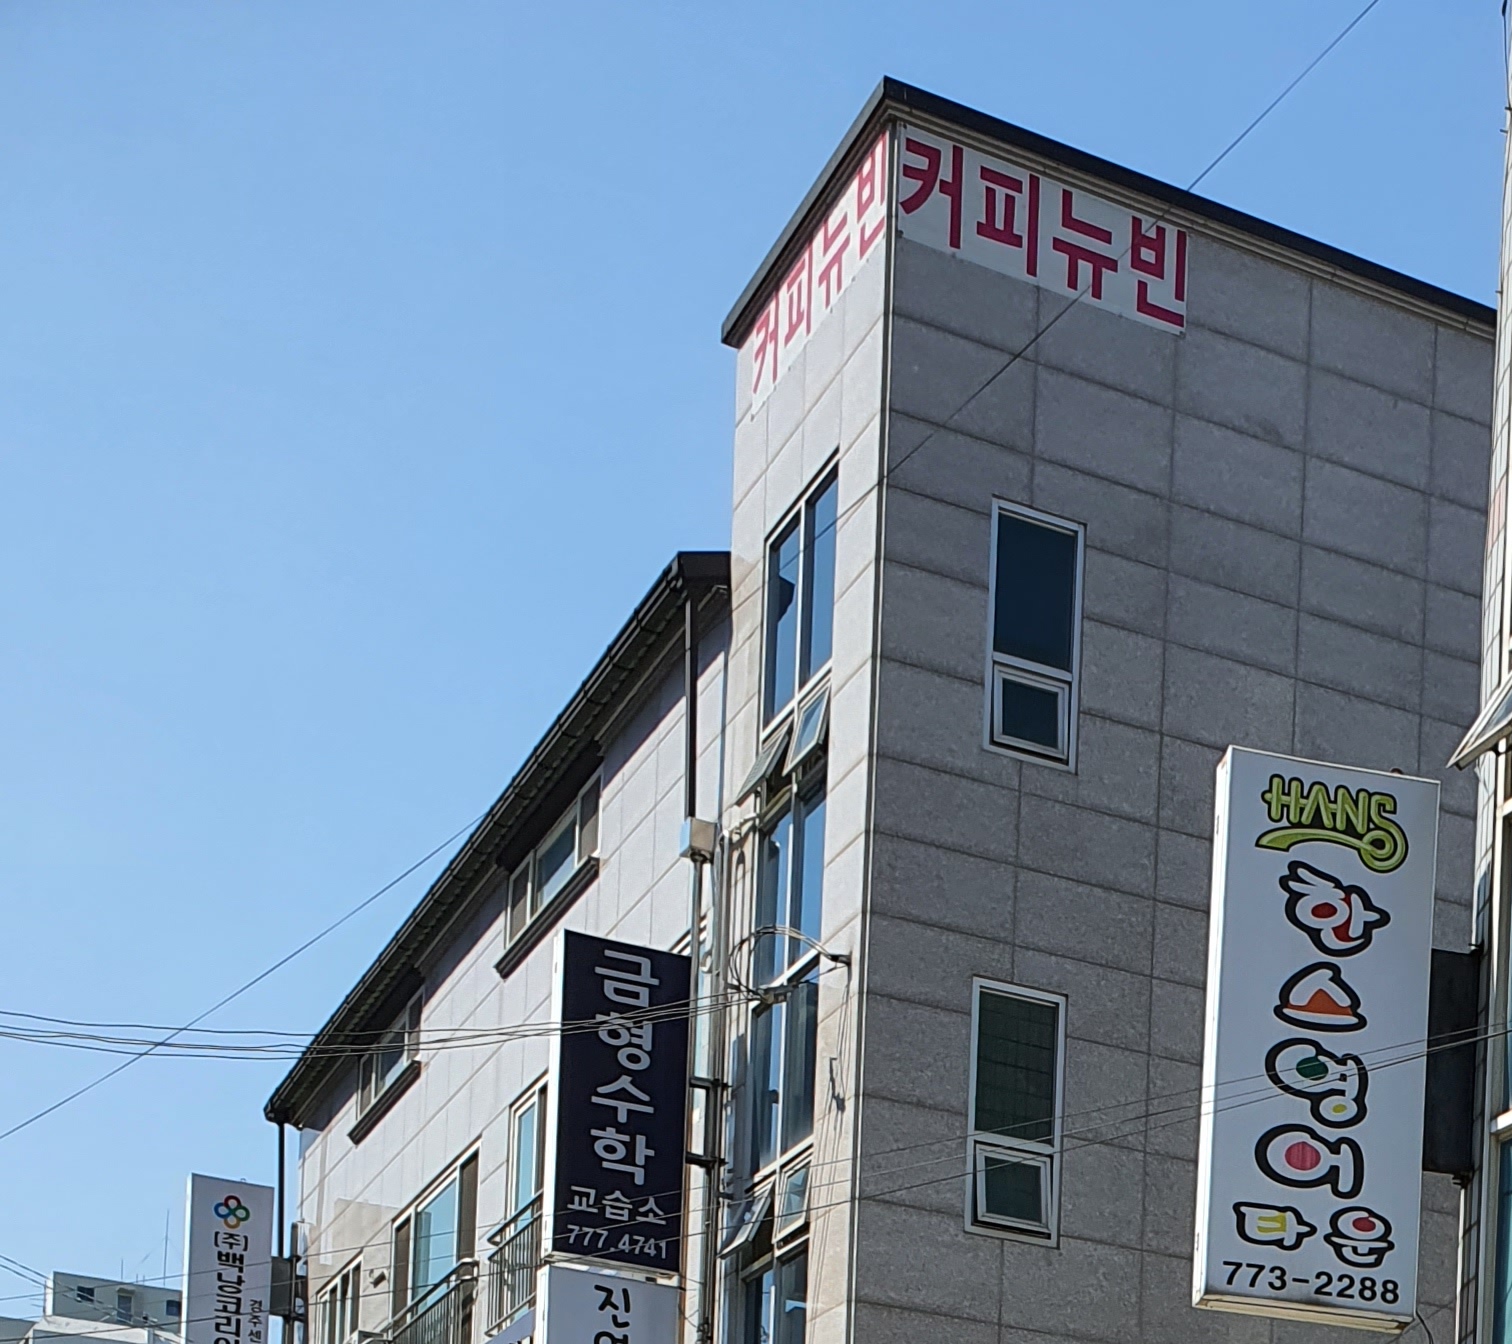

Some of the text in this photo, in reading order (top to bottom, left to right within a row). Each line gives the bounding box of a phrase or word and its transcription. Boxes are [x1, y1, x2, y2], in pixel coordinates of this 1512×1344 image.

[752, 132, 888, 395] 커피뉴빈
[900, 137, 1187, 328] 커피뉴빈
[1256, 774, 1408, 874] HANS
[590, 949, 660, 1186] 금형수학
[567, 1185, 667, 1225] 교습소
[567, 1224, 667, 1260] 777.4741
[1222, 1261, 1400, 1304] 773-2288
